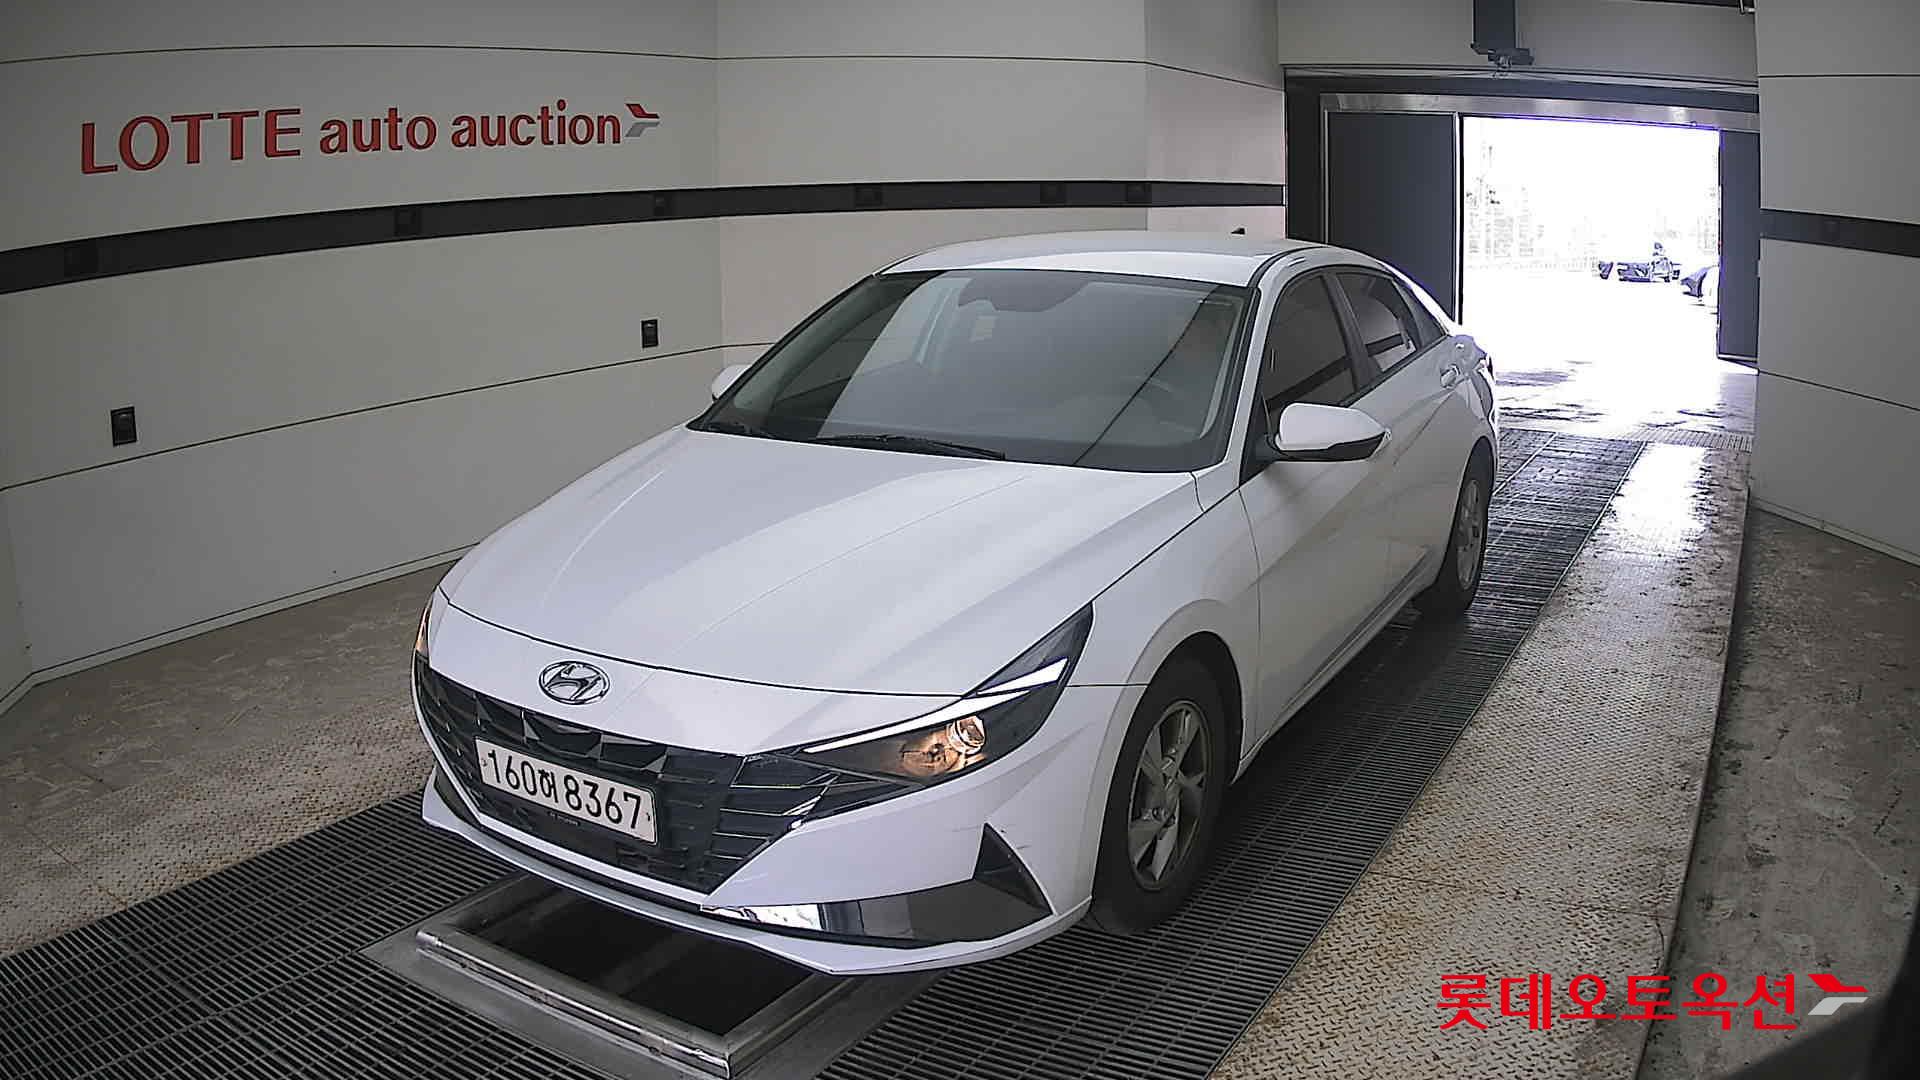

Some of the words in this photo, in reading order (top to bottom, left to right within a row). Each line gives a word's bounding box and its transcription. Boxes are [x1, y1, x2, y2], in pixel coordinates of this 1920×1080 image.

[81, 108, 301, 174] LOTTE
[319, 106, 437, 154] auto
[450, 99, 621, 147] auction
